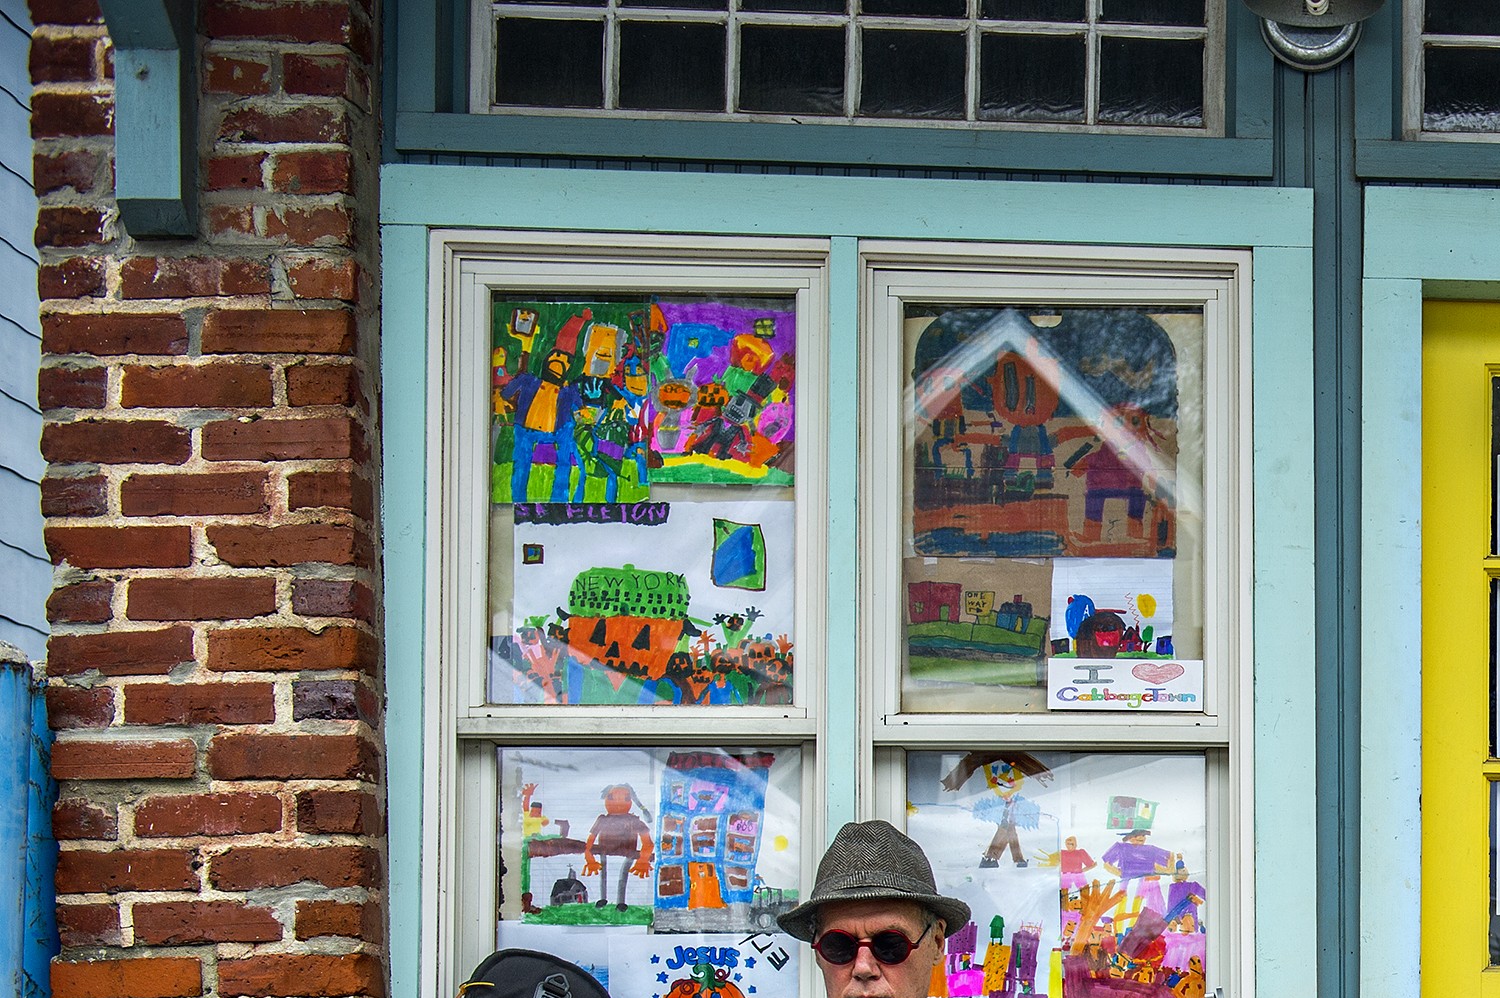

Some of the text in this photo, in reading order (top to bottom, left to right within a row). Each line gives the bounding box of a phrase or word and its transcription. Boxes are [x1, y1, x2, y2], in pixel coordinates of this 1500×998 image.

[575, 571, 687, 592] NEW YORK
[967, 591, 986, 600] ONE
[967, 600, 987, 608] WAY
[1072, 664, 1115, 684] I
[1056, 686, 1196, 708] CabbageTown
[666, 945, 740, 970] Jesus
